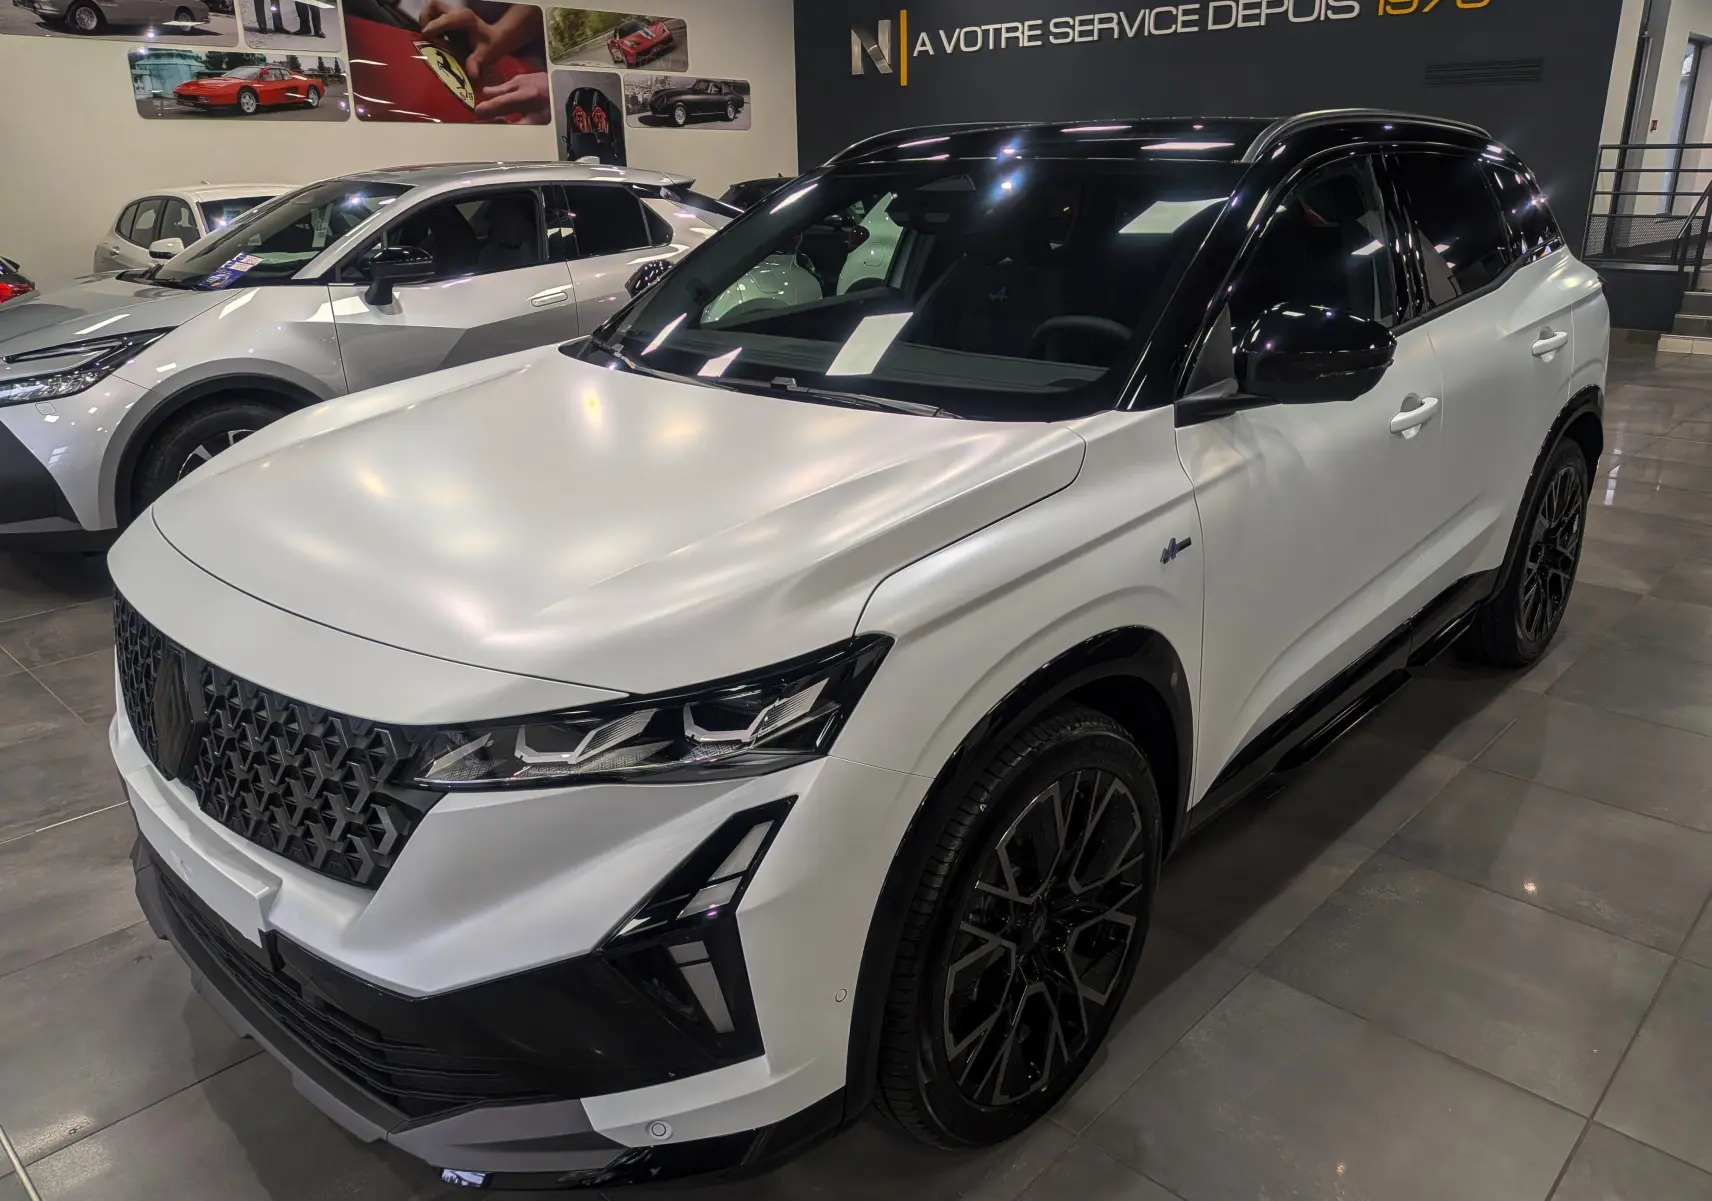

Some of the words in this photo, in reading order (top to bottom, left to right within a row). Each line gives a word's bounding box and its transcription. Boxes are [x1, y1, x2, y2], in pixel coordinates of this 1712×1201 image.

[851, 19, 893, 75] N
[913, 32, 935, 57] A
[939, 19, 1043, 54] VOTRE
[1049, 4, 1199, 44] SERVICE
[1208, 0, 1360, 31] DEPUIS
[1377, 0, 1491, 16] 19
